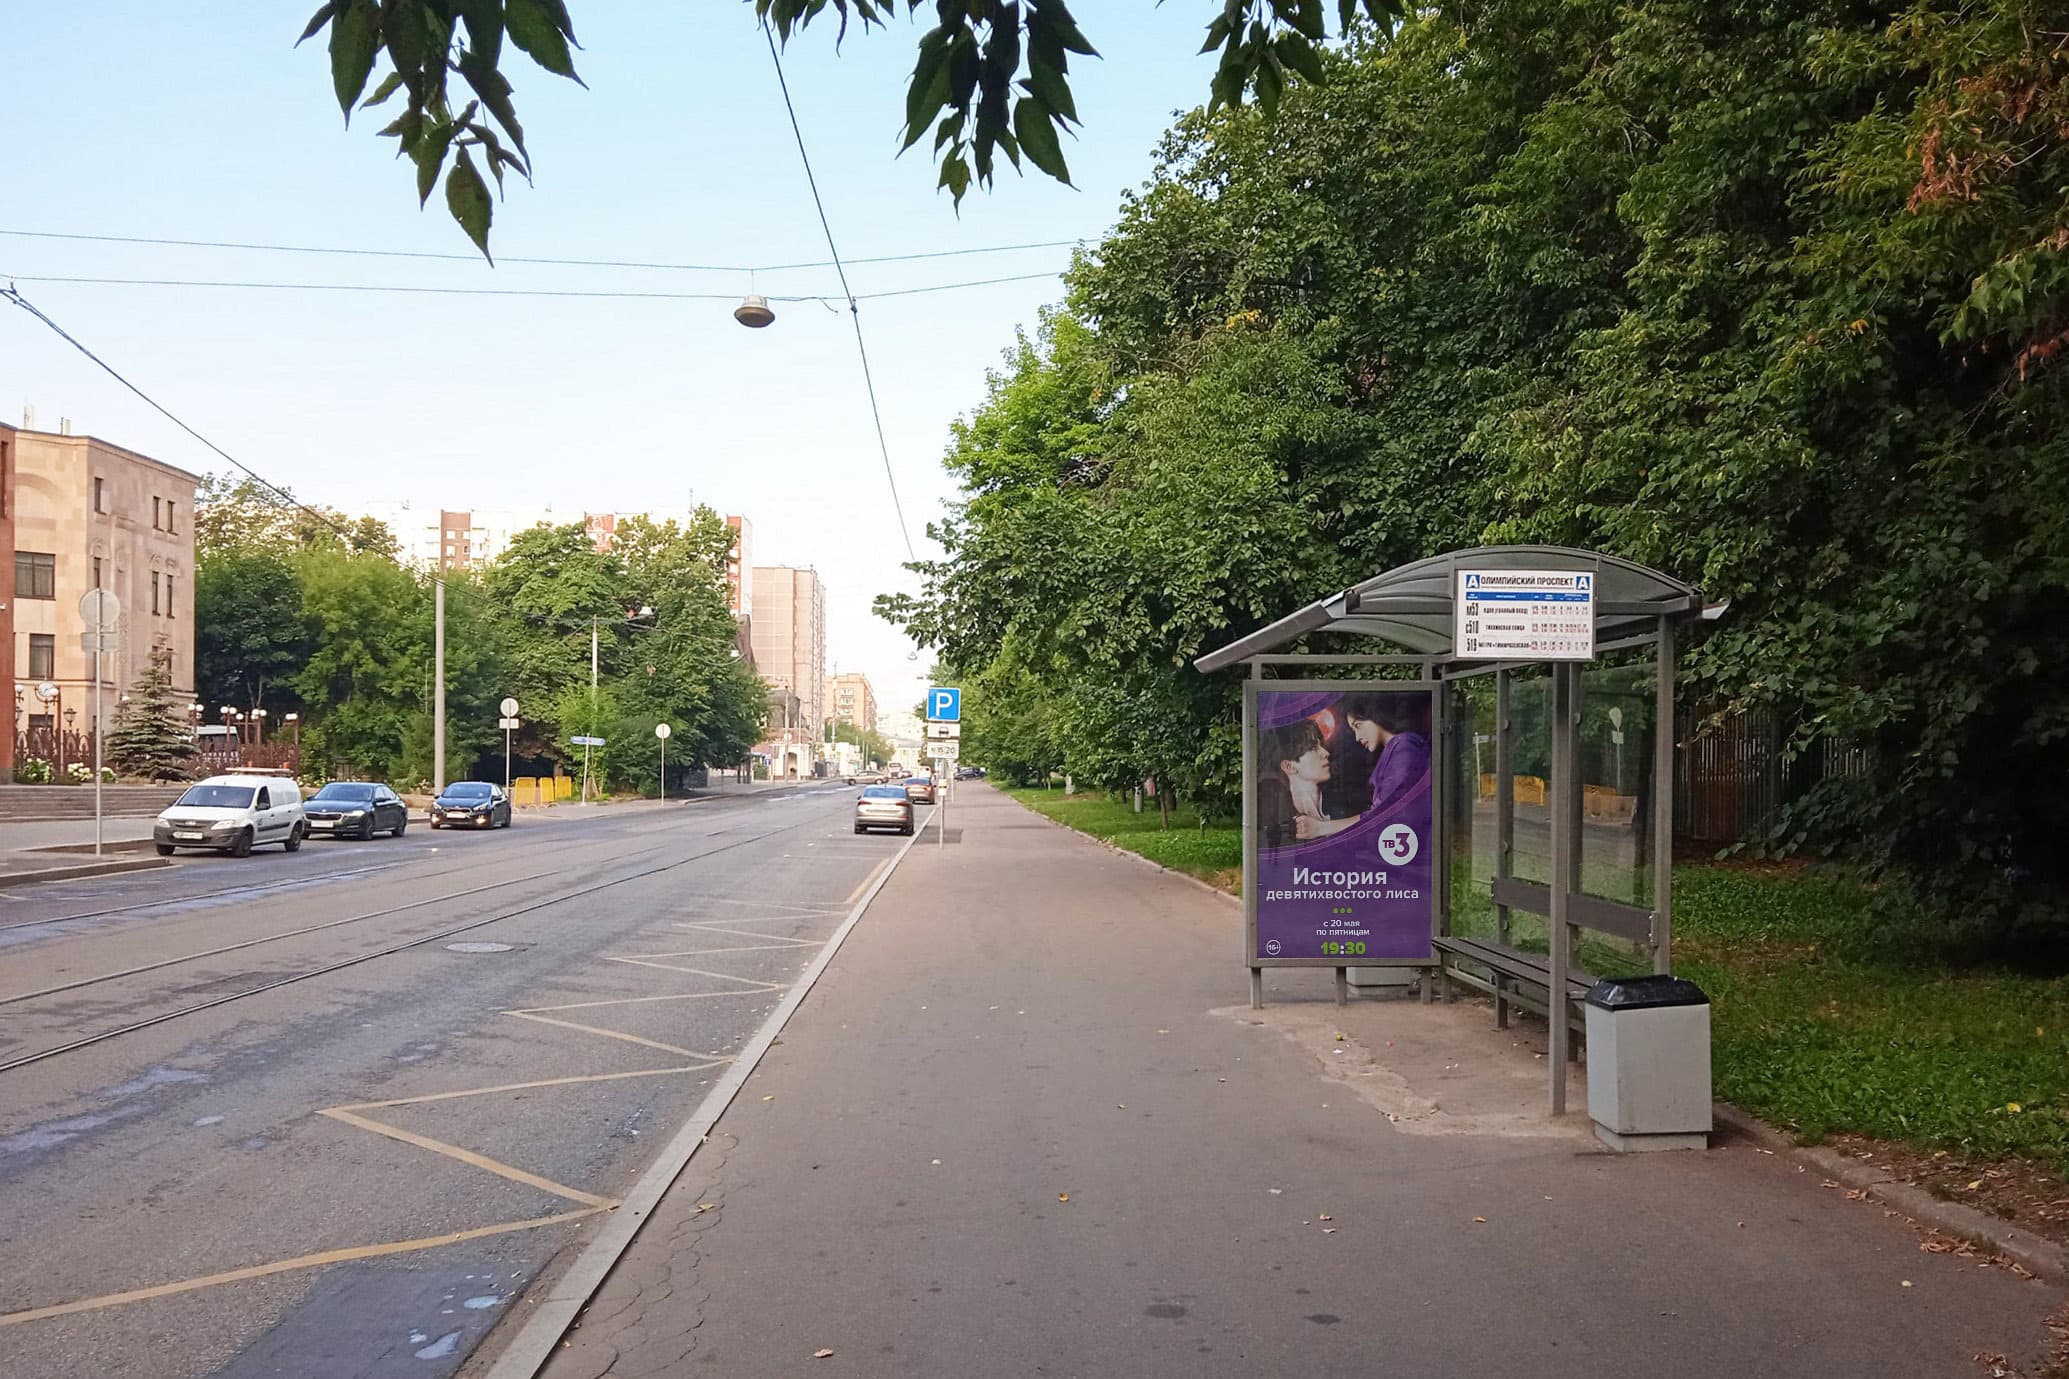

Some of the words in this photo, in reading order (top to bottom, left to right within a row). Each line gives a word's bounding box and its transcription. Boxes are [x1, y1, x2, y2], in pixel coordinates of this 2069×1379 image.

[1480, 576, 1536, 585] ОЛИМПИЙСКИЙ
[1536, 576, 1574, 586] ПРОСПЕКТ
[936, 692, 953, 717] P
[1293, 868, 1387, 889] История
[1266, 889, 1382, 901] девятихвостого
[1386, 889, 1419, 900] лиса
[1321, 942, 1366, 954] 19:30
